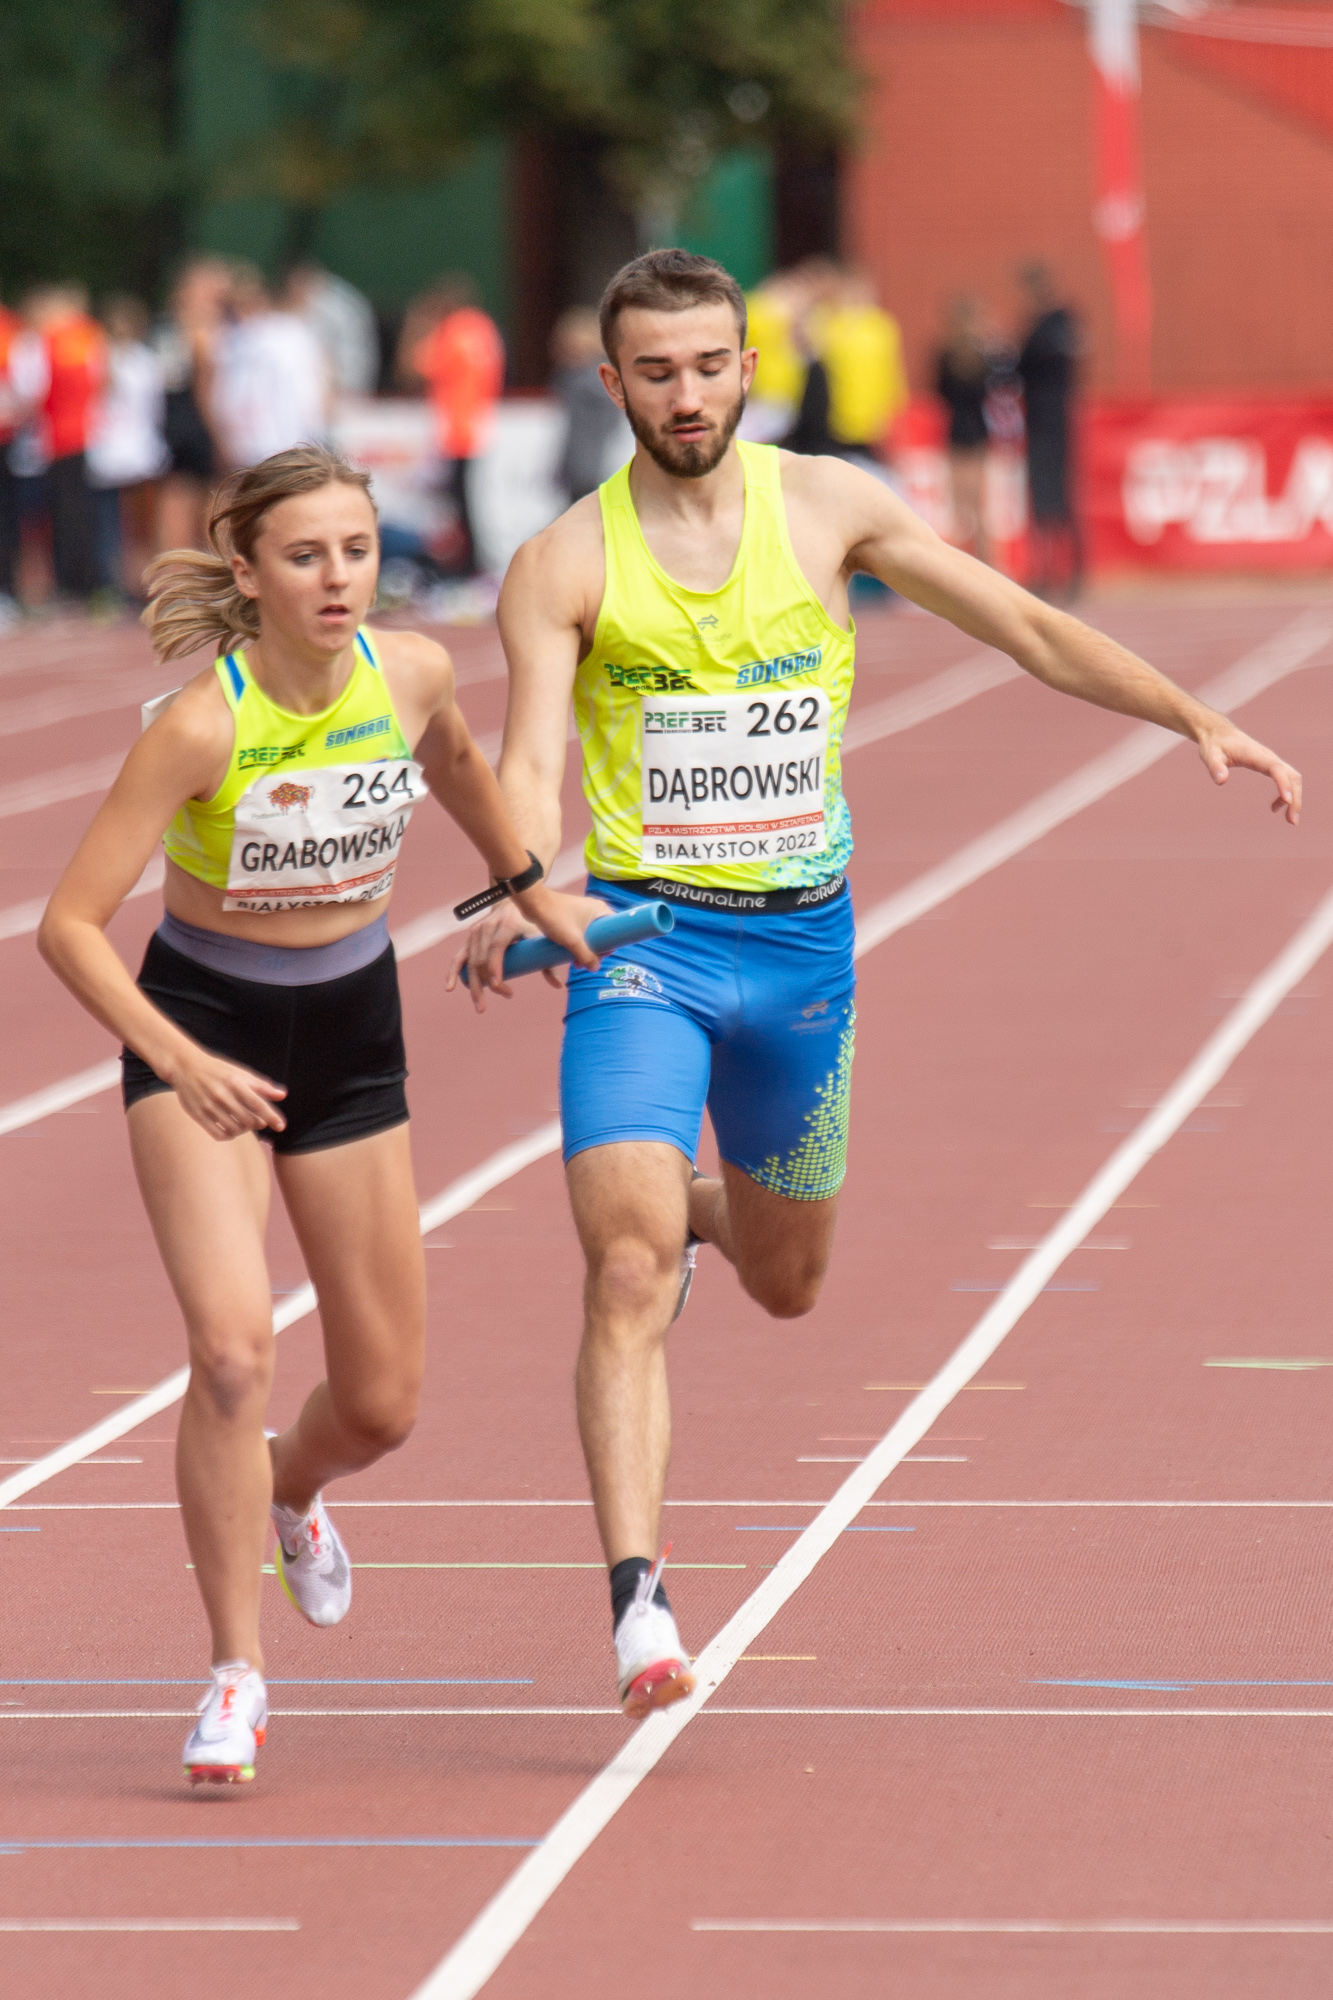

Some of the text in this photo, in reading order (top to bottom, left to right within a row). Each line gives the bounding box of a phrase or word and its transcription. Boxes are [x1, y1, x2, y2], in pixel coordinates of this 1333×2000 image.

[325, 718, 391, 748] SONAROL
[747, 697, 819, 737] 262
[343, 768, 413, 809] 264
[648, 757, 821, 811] DĄBROWSKI
[241, 816, 406, 872] GRABOWSKA
[655, 831, 817, 860] BIAŁYSTOK 2022
[672, 825, 738, 835] MISTRZOSTWA
[738, 823, 769, 832] POLSKI
[771, 822, 780, 830] W
